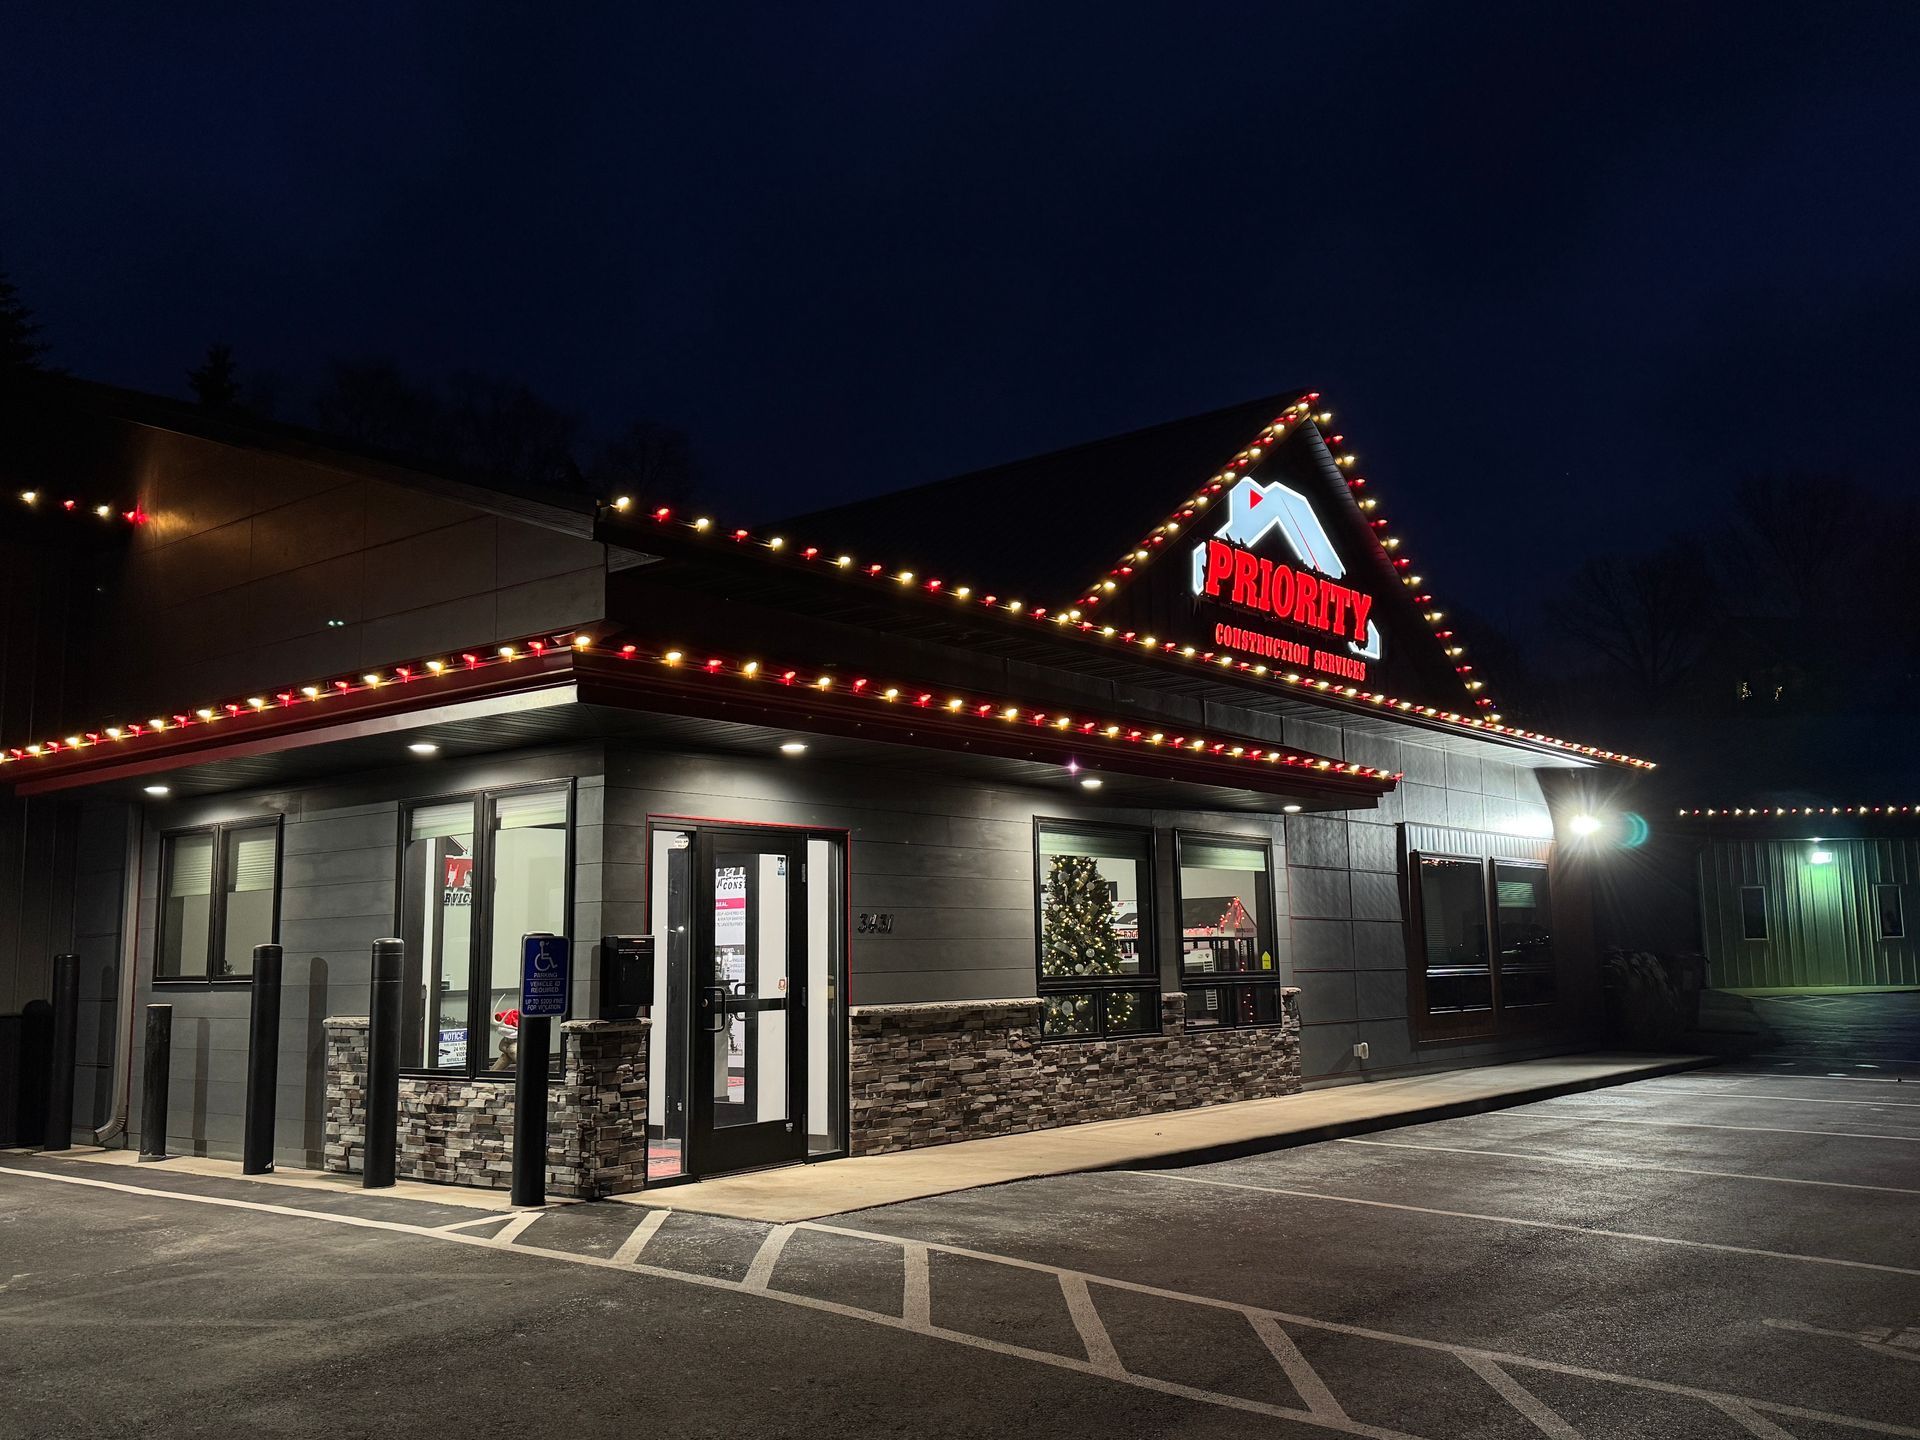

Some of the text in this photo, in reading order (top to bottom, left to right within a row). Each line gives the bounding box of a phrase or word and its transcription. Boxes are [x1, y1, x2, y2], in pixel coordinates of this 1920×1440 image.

[1205, 539, 1372, 642] PRIORITY
[1215, 622, 1366, 682] CONSTRUCTION SERVICES
[444, 892, 472, 904] RVIC
[858, 913, 895, 934] 3431
[443, 1032, 464, 1041] NOTICE
